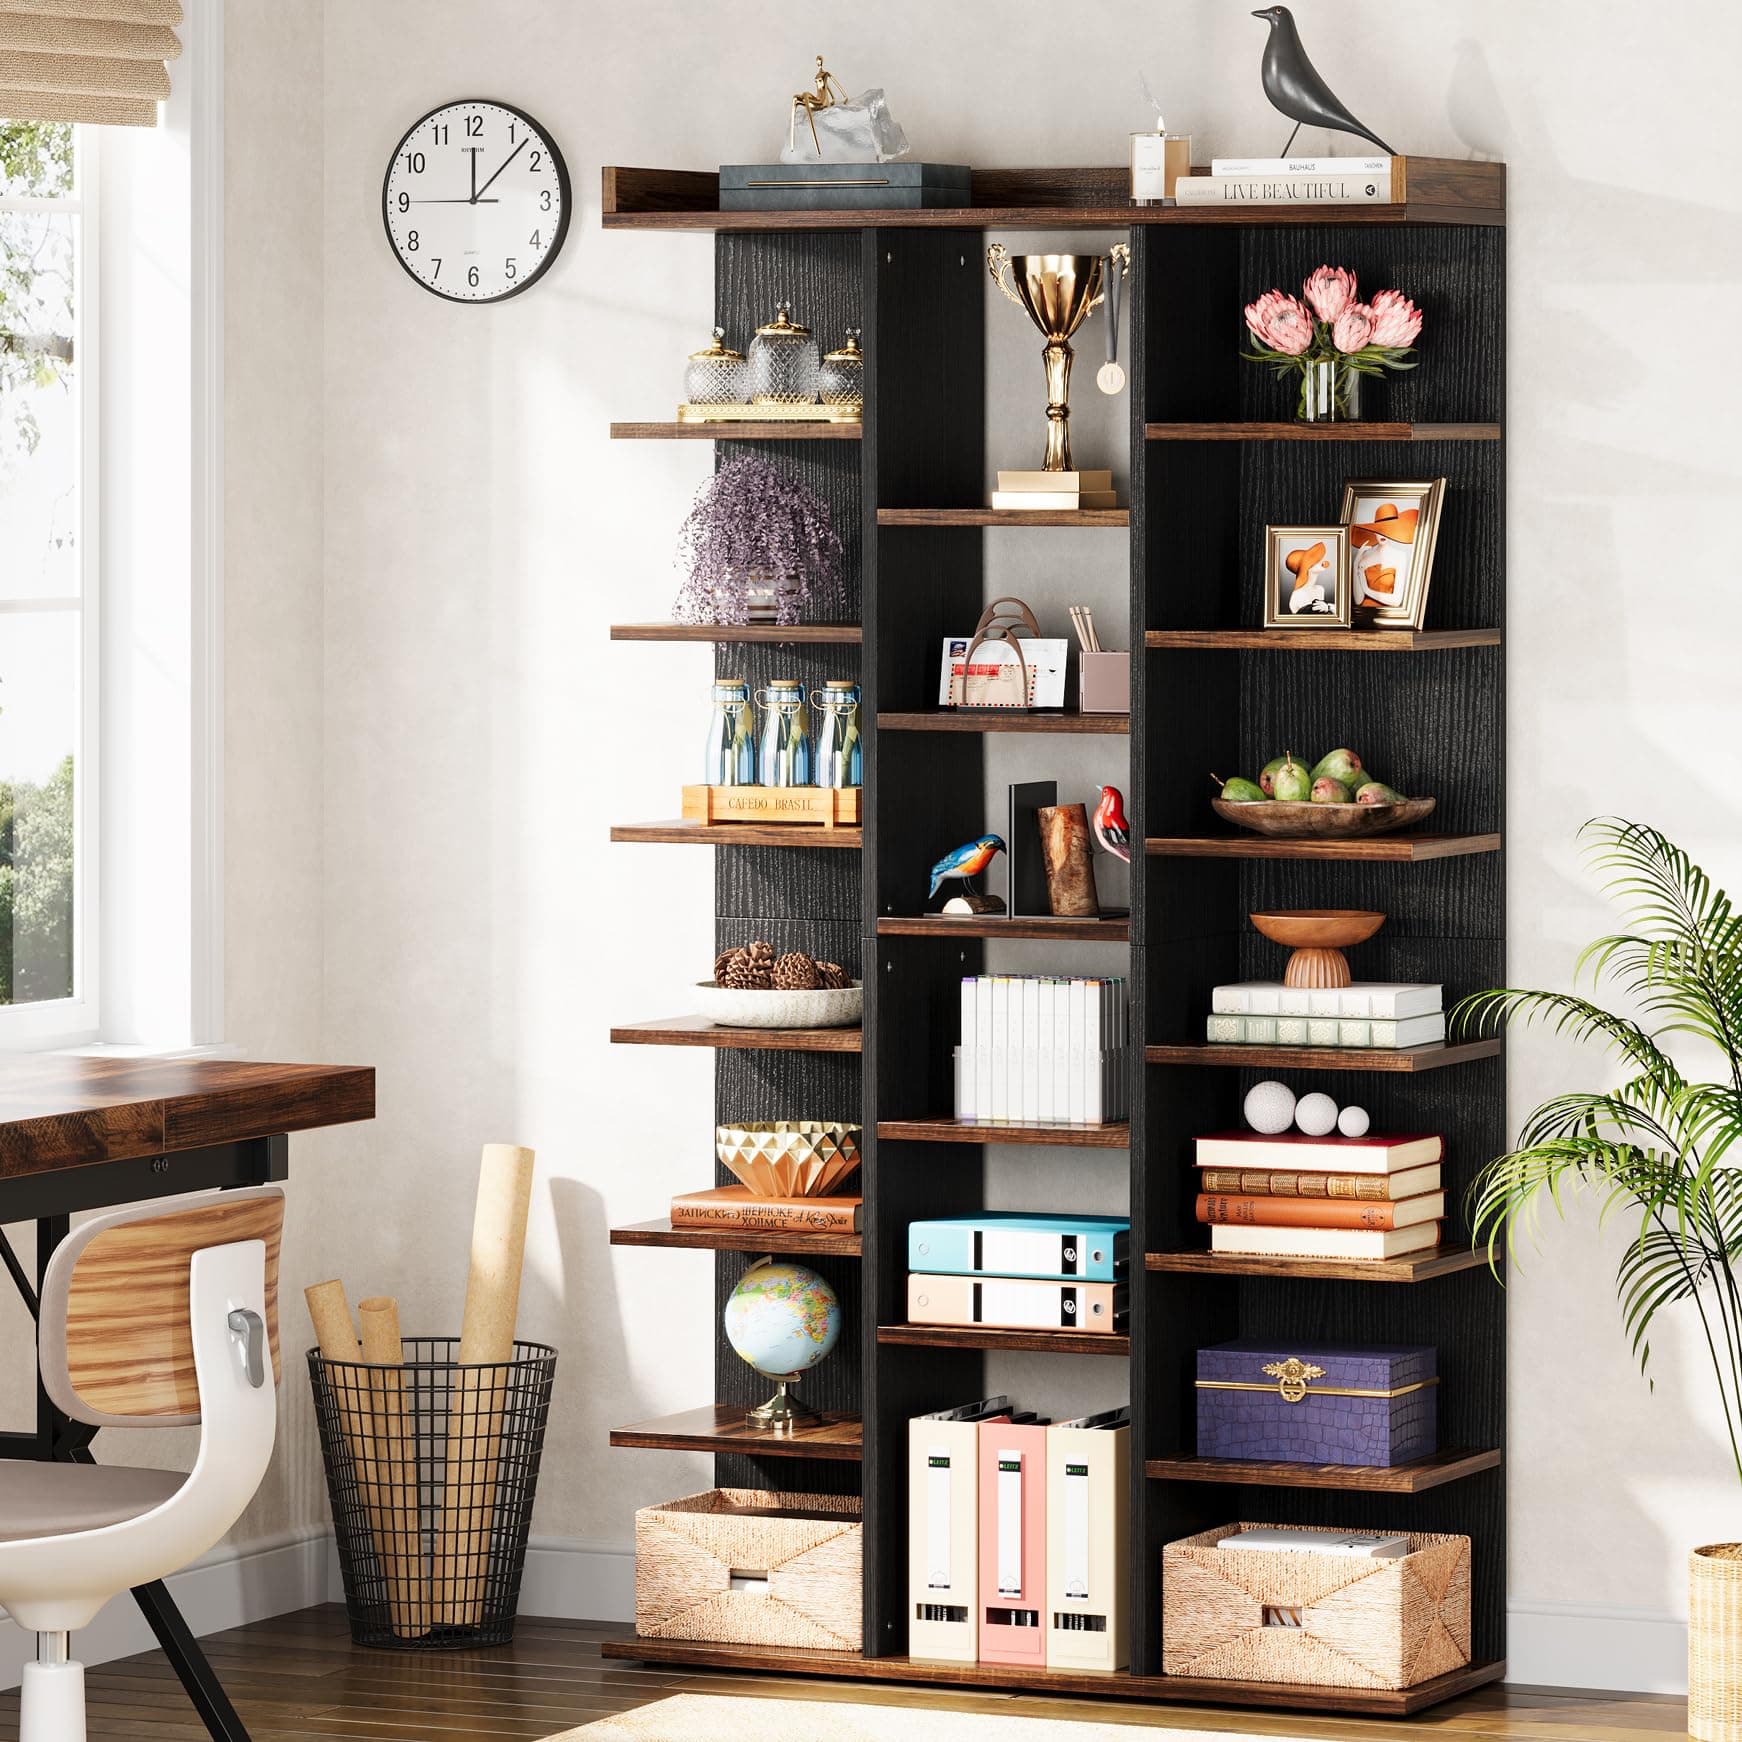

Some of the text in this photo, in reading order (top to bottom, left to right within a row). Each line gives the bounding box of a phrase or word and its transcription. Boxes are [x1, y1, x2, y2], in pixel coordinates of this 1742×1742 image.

[432, 124, 448, 145] 11
[464, 115, 483, 136] 12
[508, 123, 514, 144] 1
[405, 152, 425, 174] 10
[529, 151, 541, 172] 2
[1289, 163, 1316, 171] BAUHAUS
[540, 190, 551, 211] 3
[1224, 184, 1258, 200] LIVE
[1263, 183, 1350, 199] BEAUTIFUL
[399, 192, 409, 213] 9
[408, 230, 419, 251] 8
[529, 229, 541, 250] 4
[431, 258, 442, 279] 7
[468, 266, 479, 287] 6
[505, 258, 516, 279] 5
[775, 799, 814, 811] BRASIL
